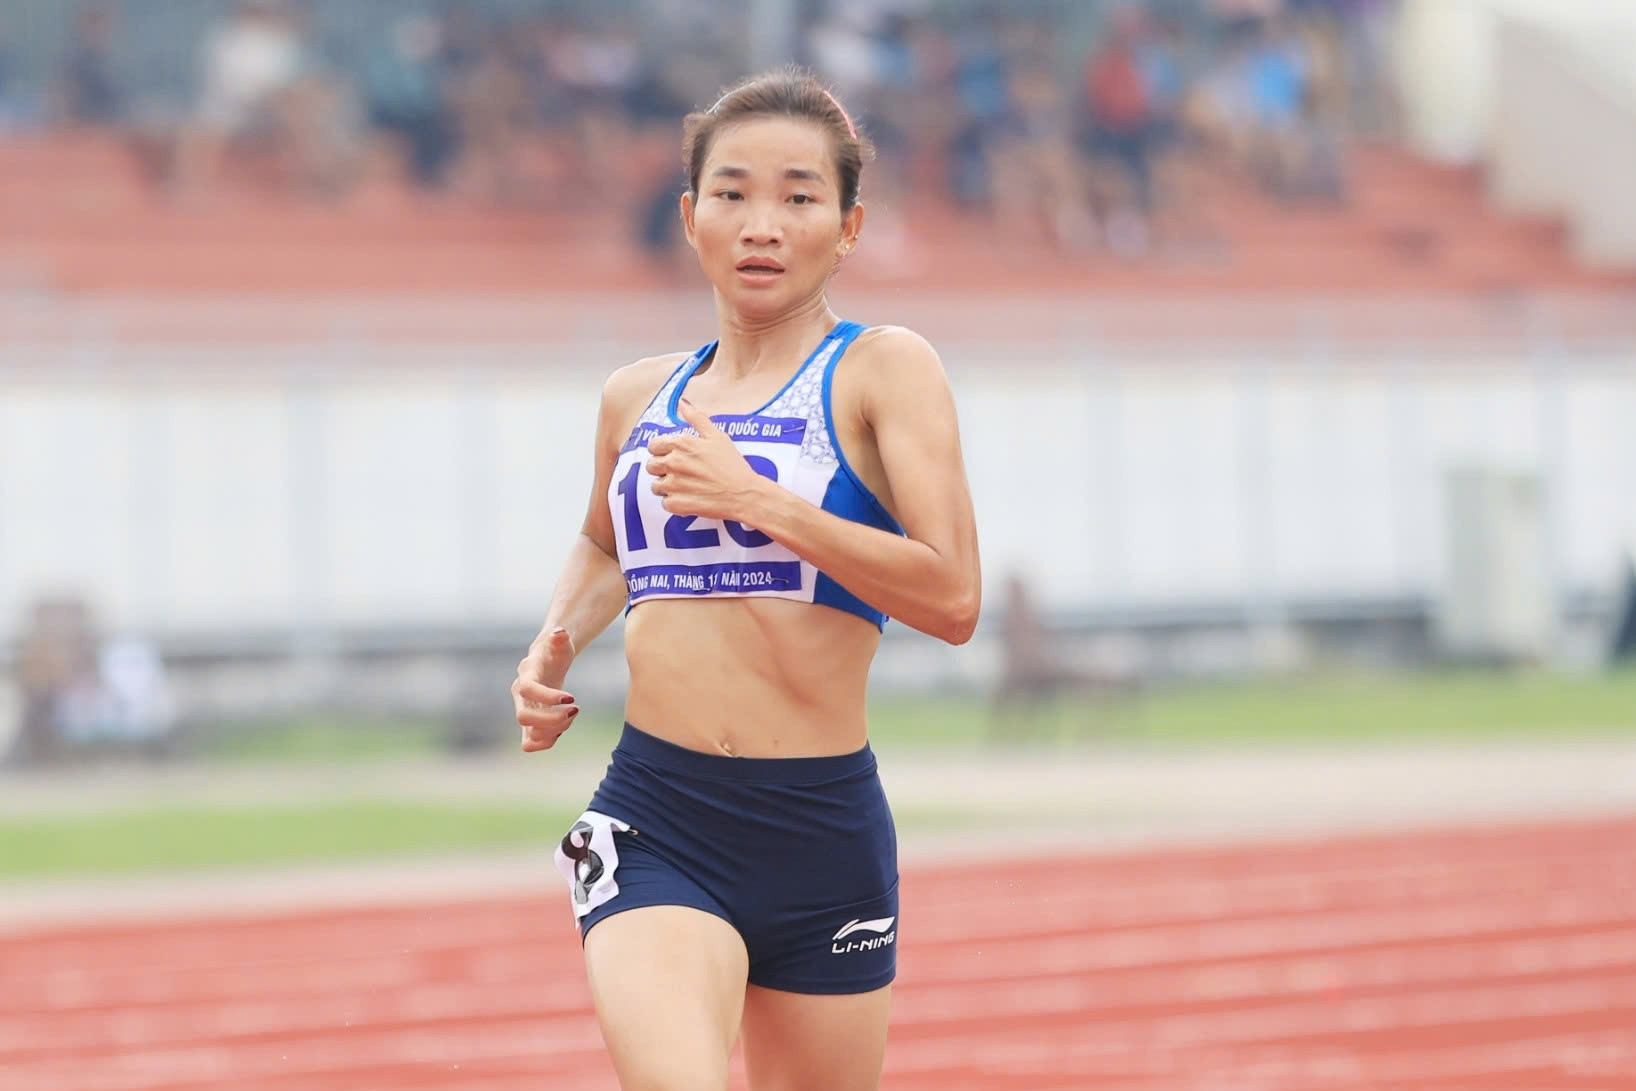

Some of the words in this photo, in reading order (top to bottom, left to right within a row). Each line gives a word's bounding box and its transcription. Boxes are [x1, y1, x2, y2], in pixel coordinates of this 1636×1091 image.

[728, 418, 760, 437] QUỐC
[761, 423, 782, 438] GIA
[650, 574, 670, 591] NAI,
[674, 572, 705, 589] THÁNG
[743, 571, 772, 587] 2024
[831, 930, 896, 954] LI-NING
